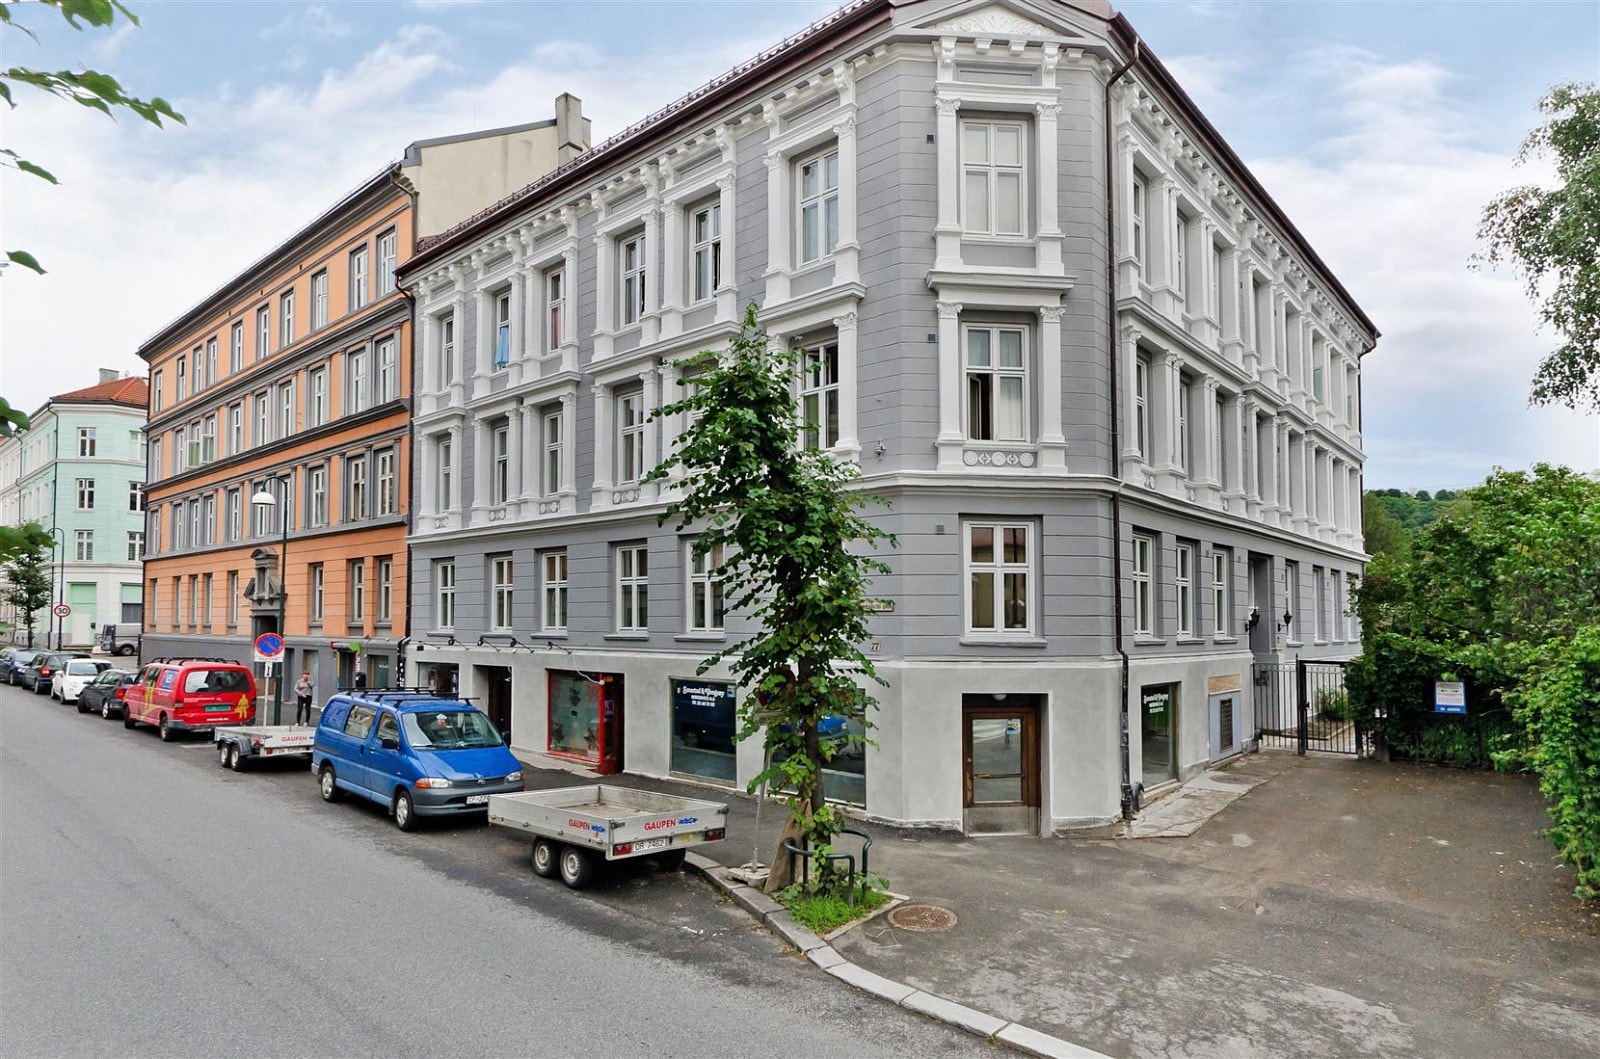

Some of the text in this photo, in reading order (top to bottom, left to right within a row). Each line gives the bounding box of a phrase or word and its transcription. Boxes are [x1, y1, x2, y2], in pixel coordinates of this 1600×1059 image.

[57, 607, 67, 615] 30
[871, 642, 880, 650] 77
[568, 819, 590, 831] GAUPEN
[644, 819, 676, 831] GAUPEN
